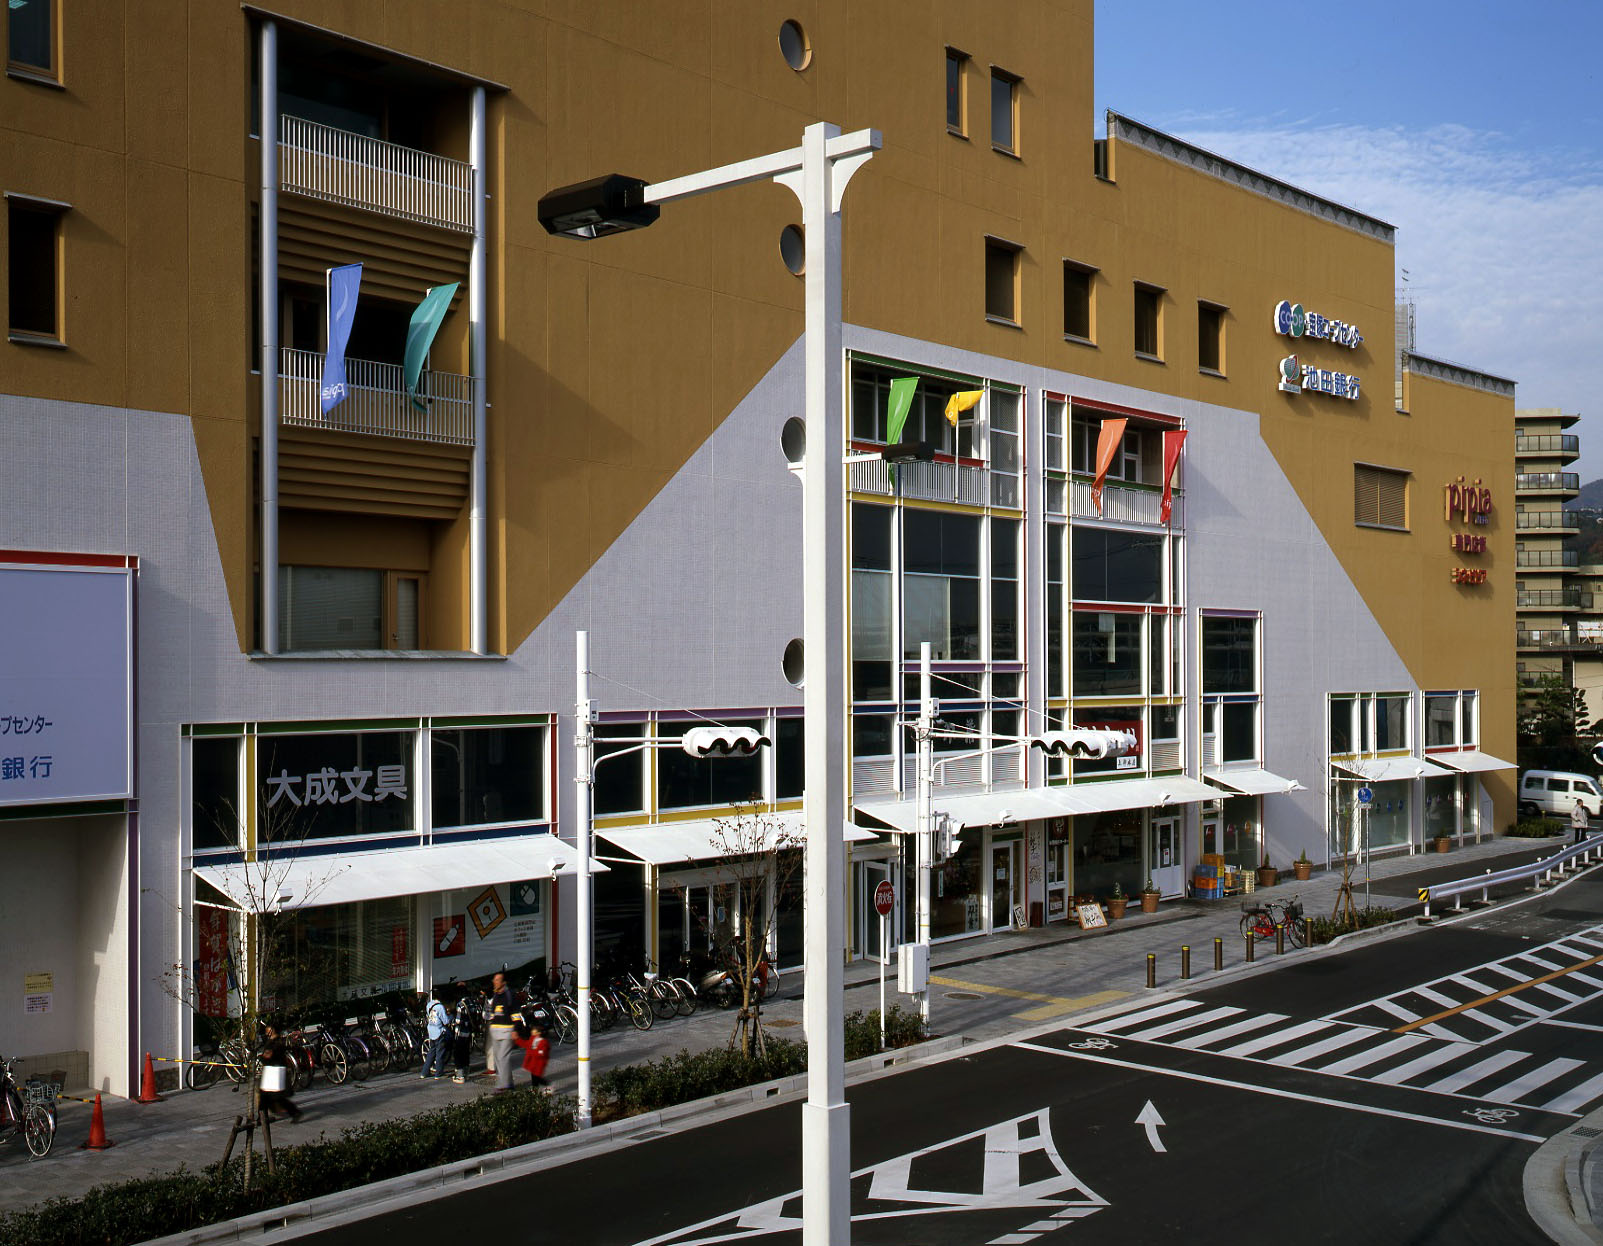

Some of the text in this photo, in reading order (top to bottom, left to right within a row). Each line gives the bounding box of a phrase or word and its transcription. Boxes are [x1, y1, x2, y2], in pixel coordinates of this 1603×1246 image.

[1302, 365, 1360, 400] 池田銀行
[1445, 476, 1492, 523] pipia
[1, 756, 53, 780] 銀行
[266, 765, 408, 808] 大成文具
